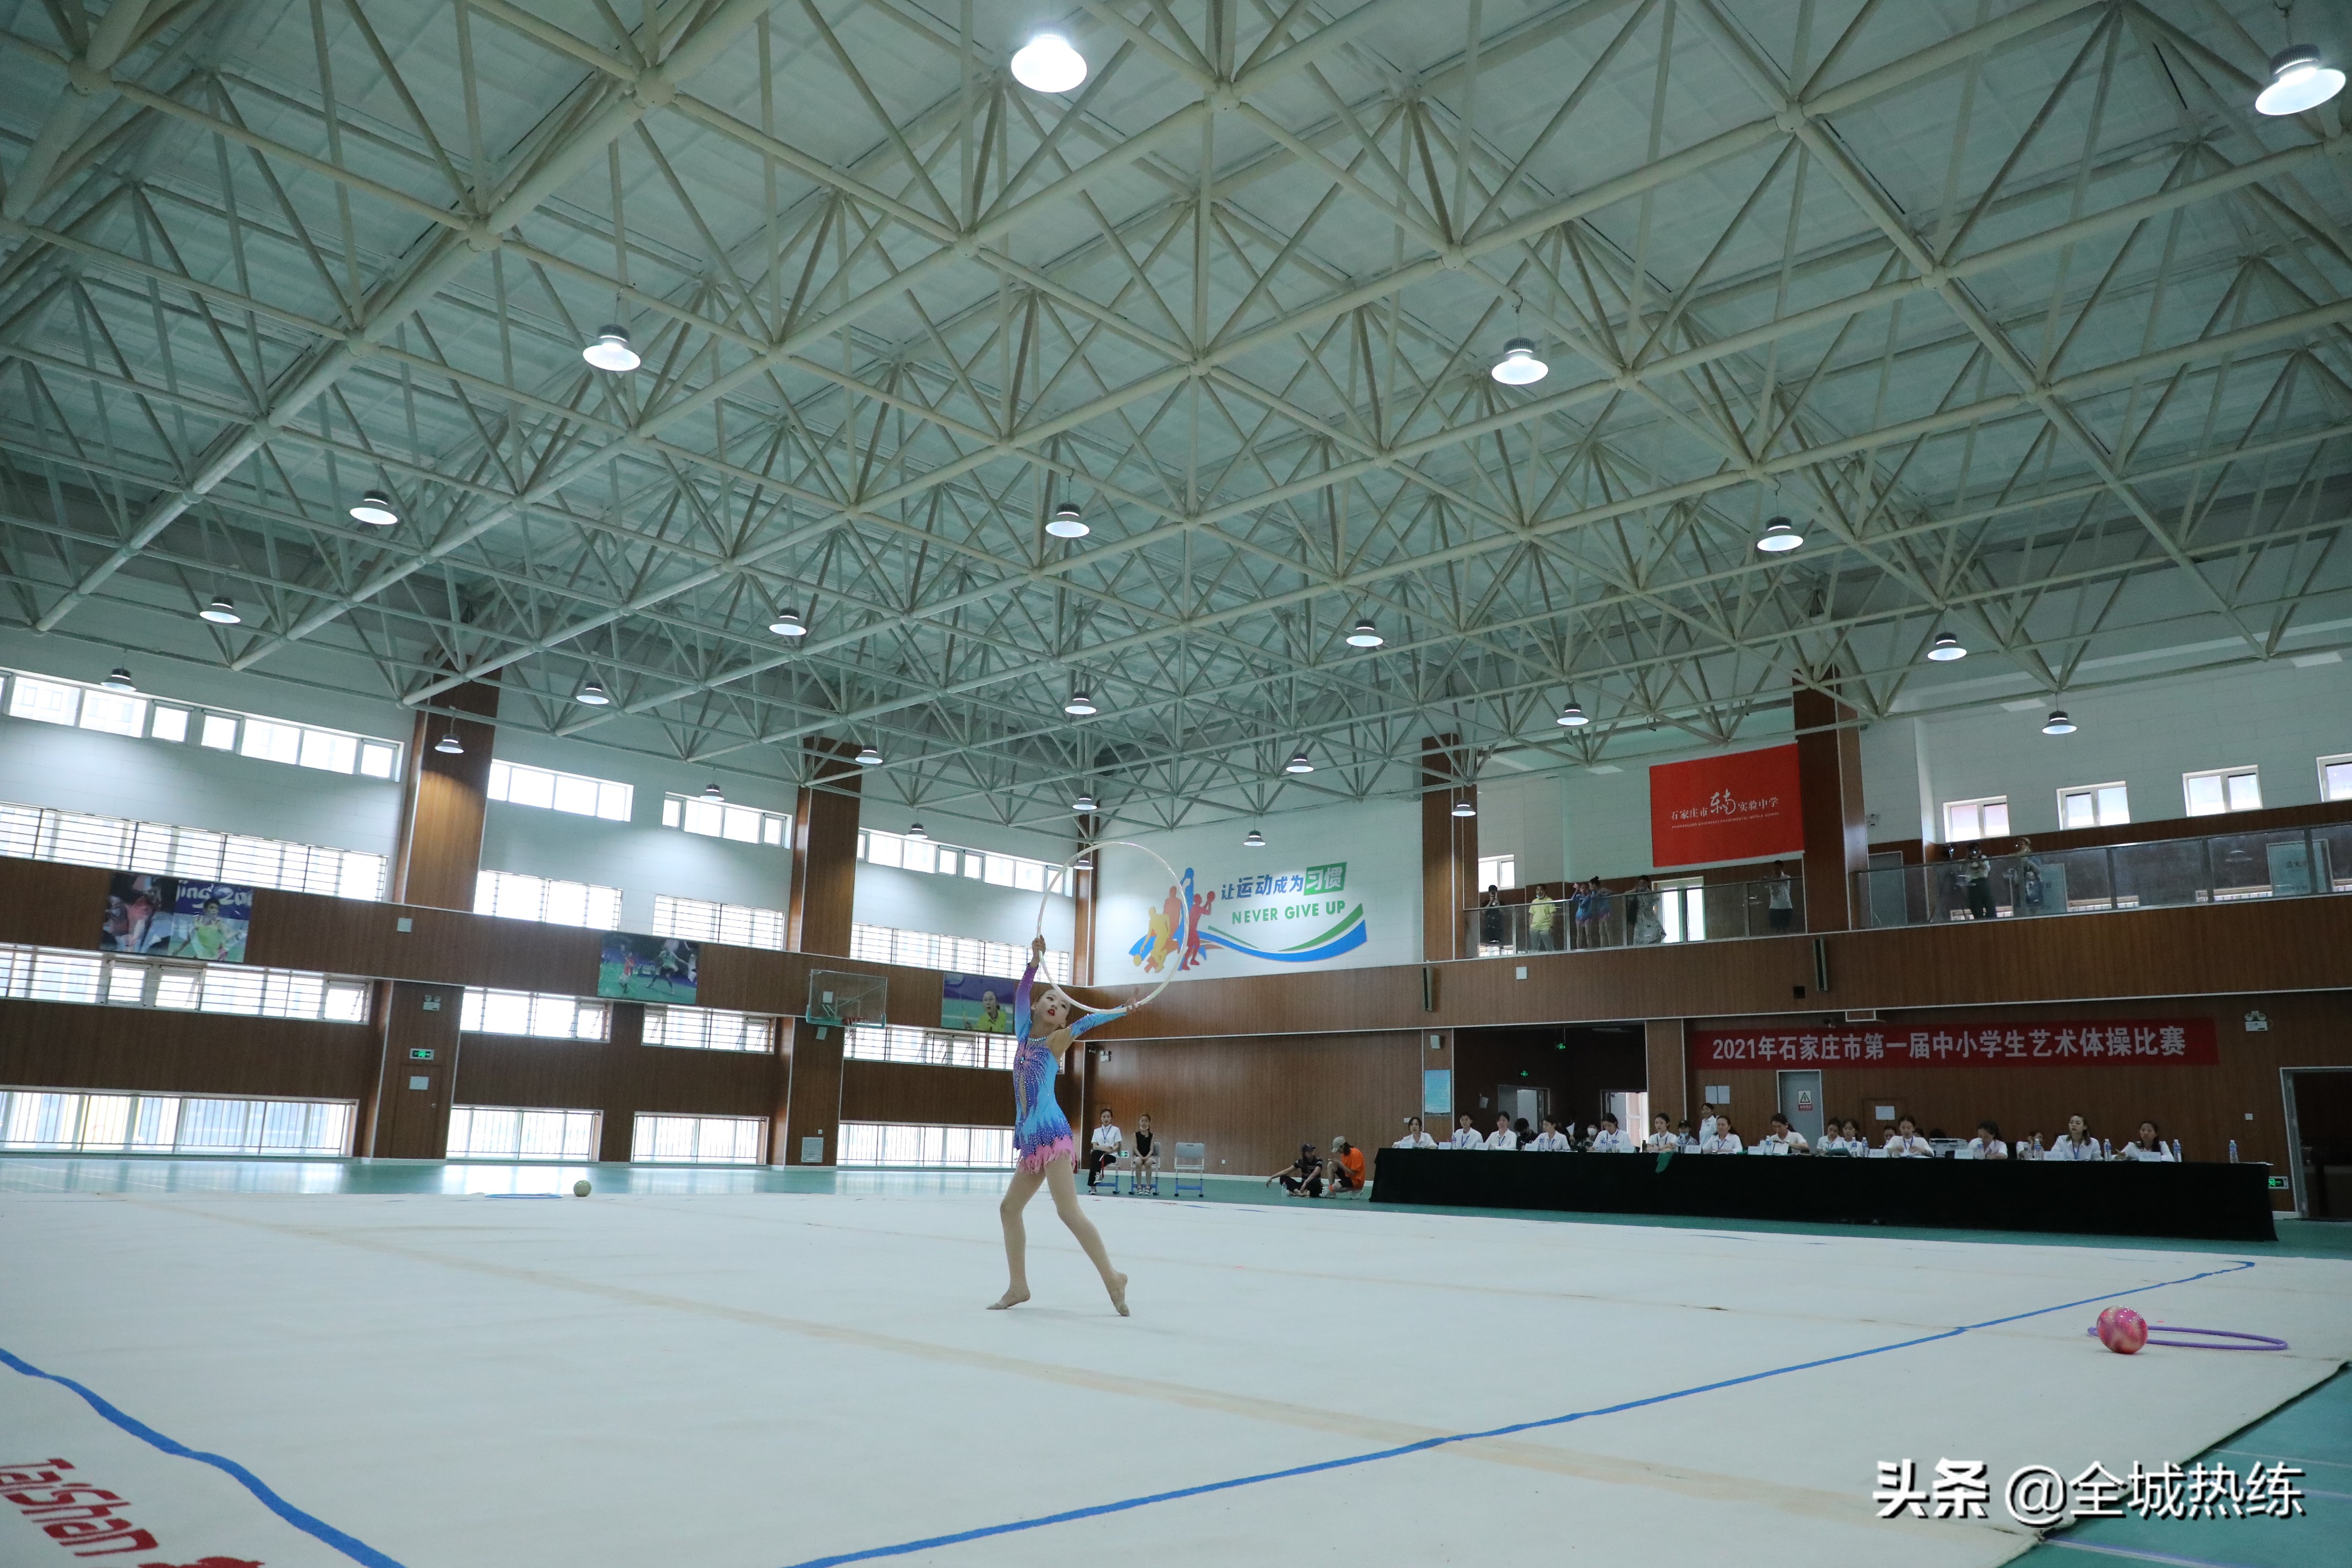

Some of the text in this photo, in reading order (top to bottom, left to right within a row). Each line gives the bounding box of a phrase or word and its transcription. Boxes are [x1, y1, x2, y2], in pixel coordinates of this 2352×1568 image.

[1221, 866, 1344, 900] 让运动成为习惯
[1232, 900, 1346, 924] NEVER GIVE UP
[1713, 1025, 2186, 1061] 2021年石家庄市第一届中小学生艺术体操比赛
